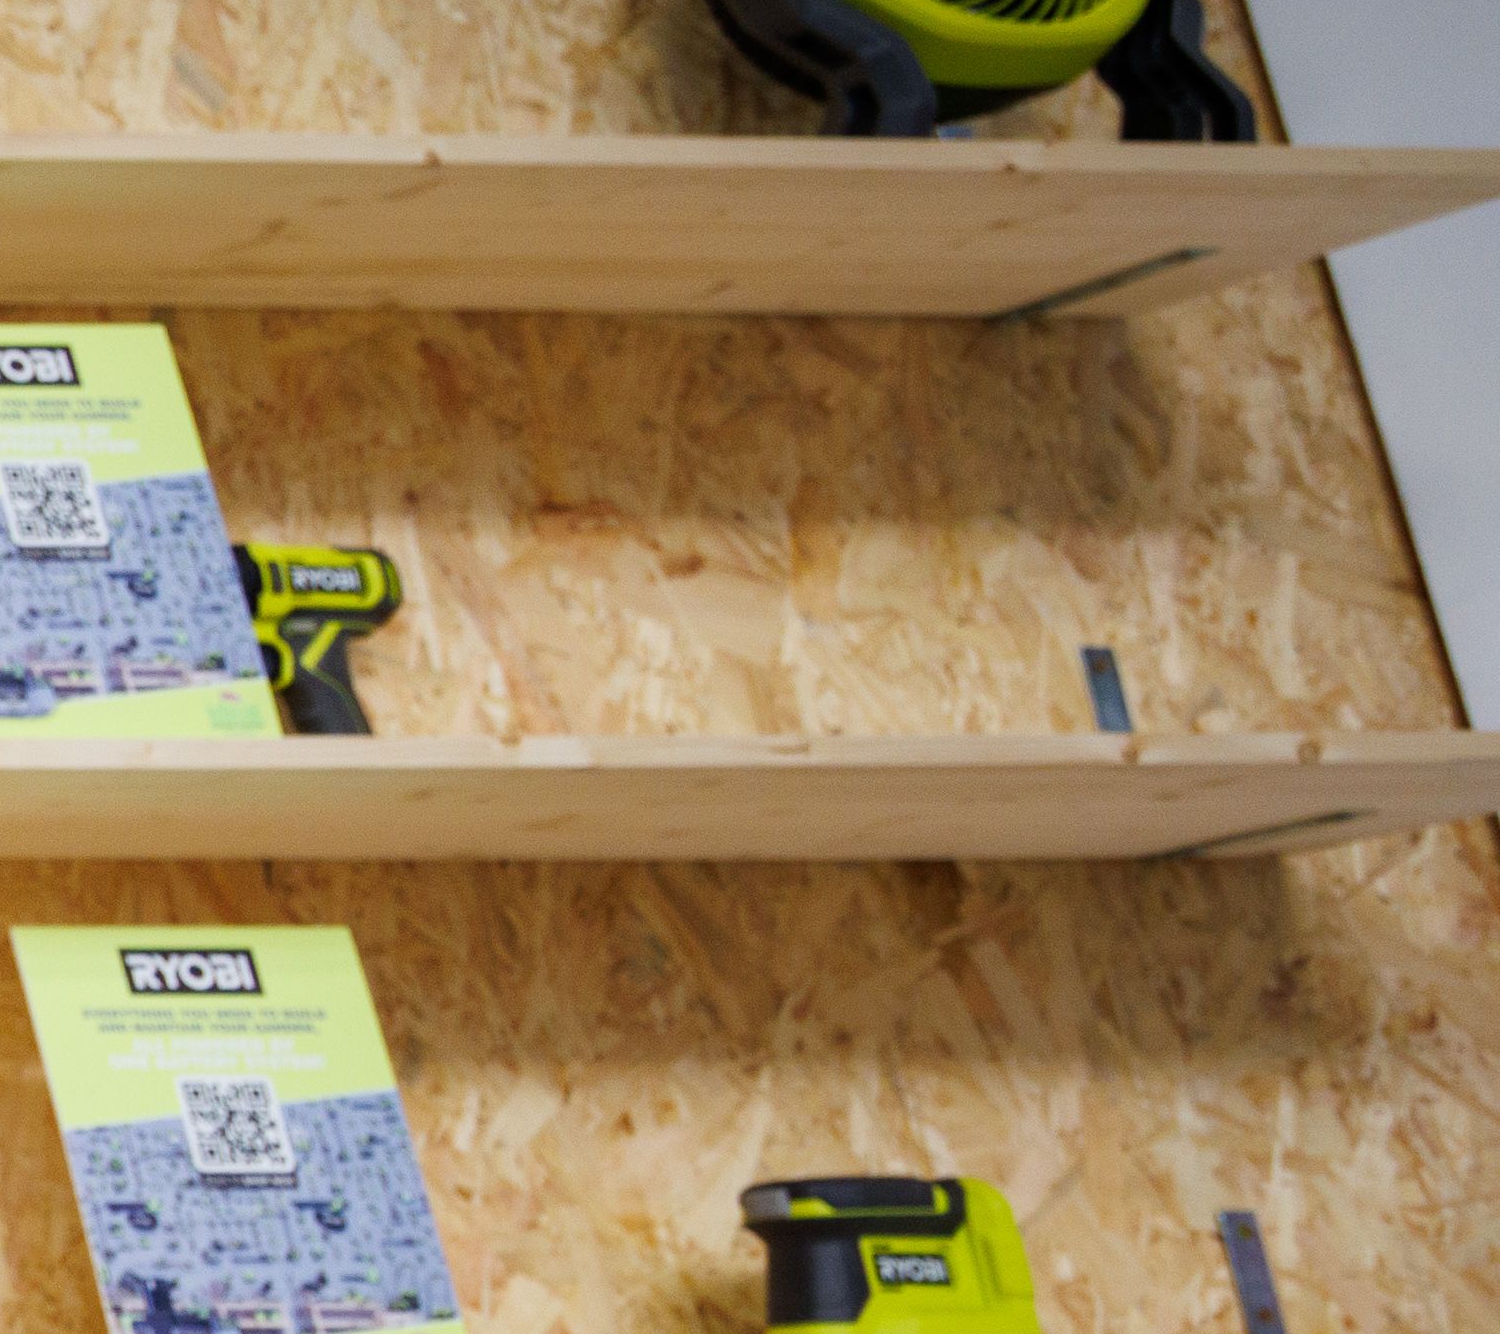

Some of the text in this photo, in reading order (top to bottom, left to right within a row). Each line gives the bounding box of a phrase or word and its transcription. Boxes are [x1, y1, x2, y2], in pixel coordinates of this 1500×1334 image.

[291, 567, 360, 592] RYOBI
[123, 952, 257, 991] RYOBI
[878, 1256, 948, 1282] RYOBI
